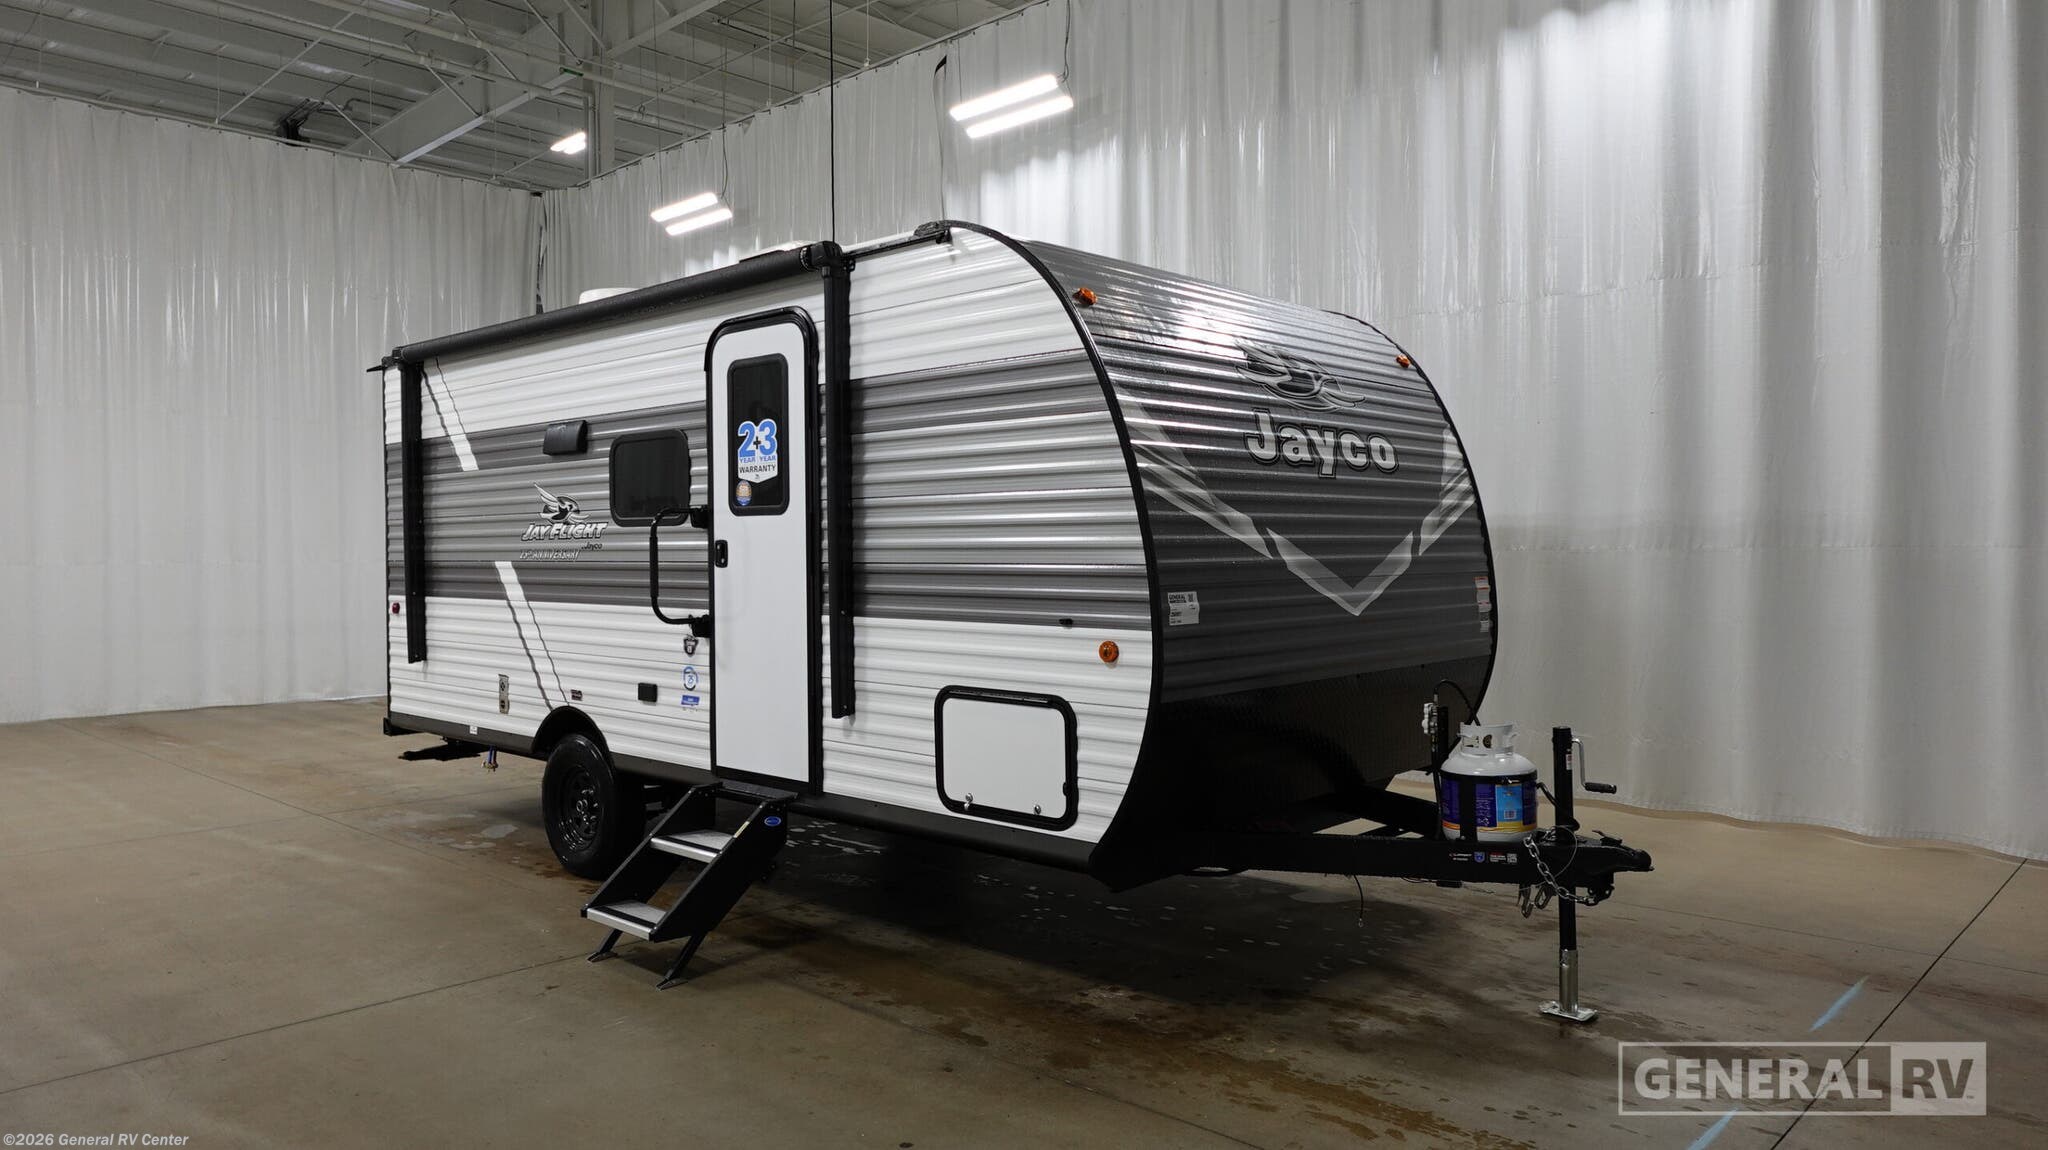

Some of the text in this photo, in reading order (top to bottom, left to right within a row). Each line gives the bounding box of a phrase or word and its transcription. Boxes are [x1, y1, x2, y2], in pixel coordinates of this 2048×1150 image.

[1244, 408, 1399, 479] Jayco
[740, 456, 756, 464] YEAR
[739, 464, 776, 474] WARRANTY
[521, 522, 608, 541] JAY FLIGHT
